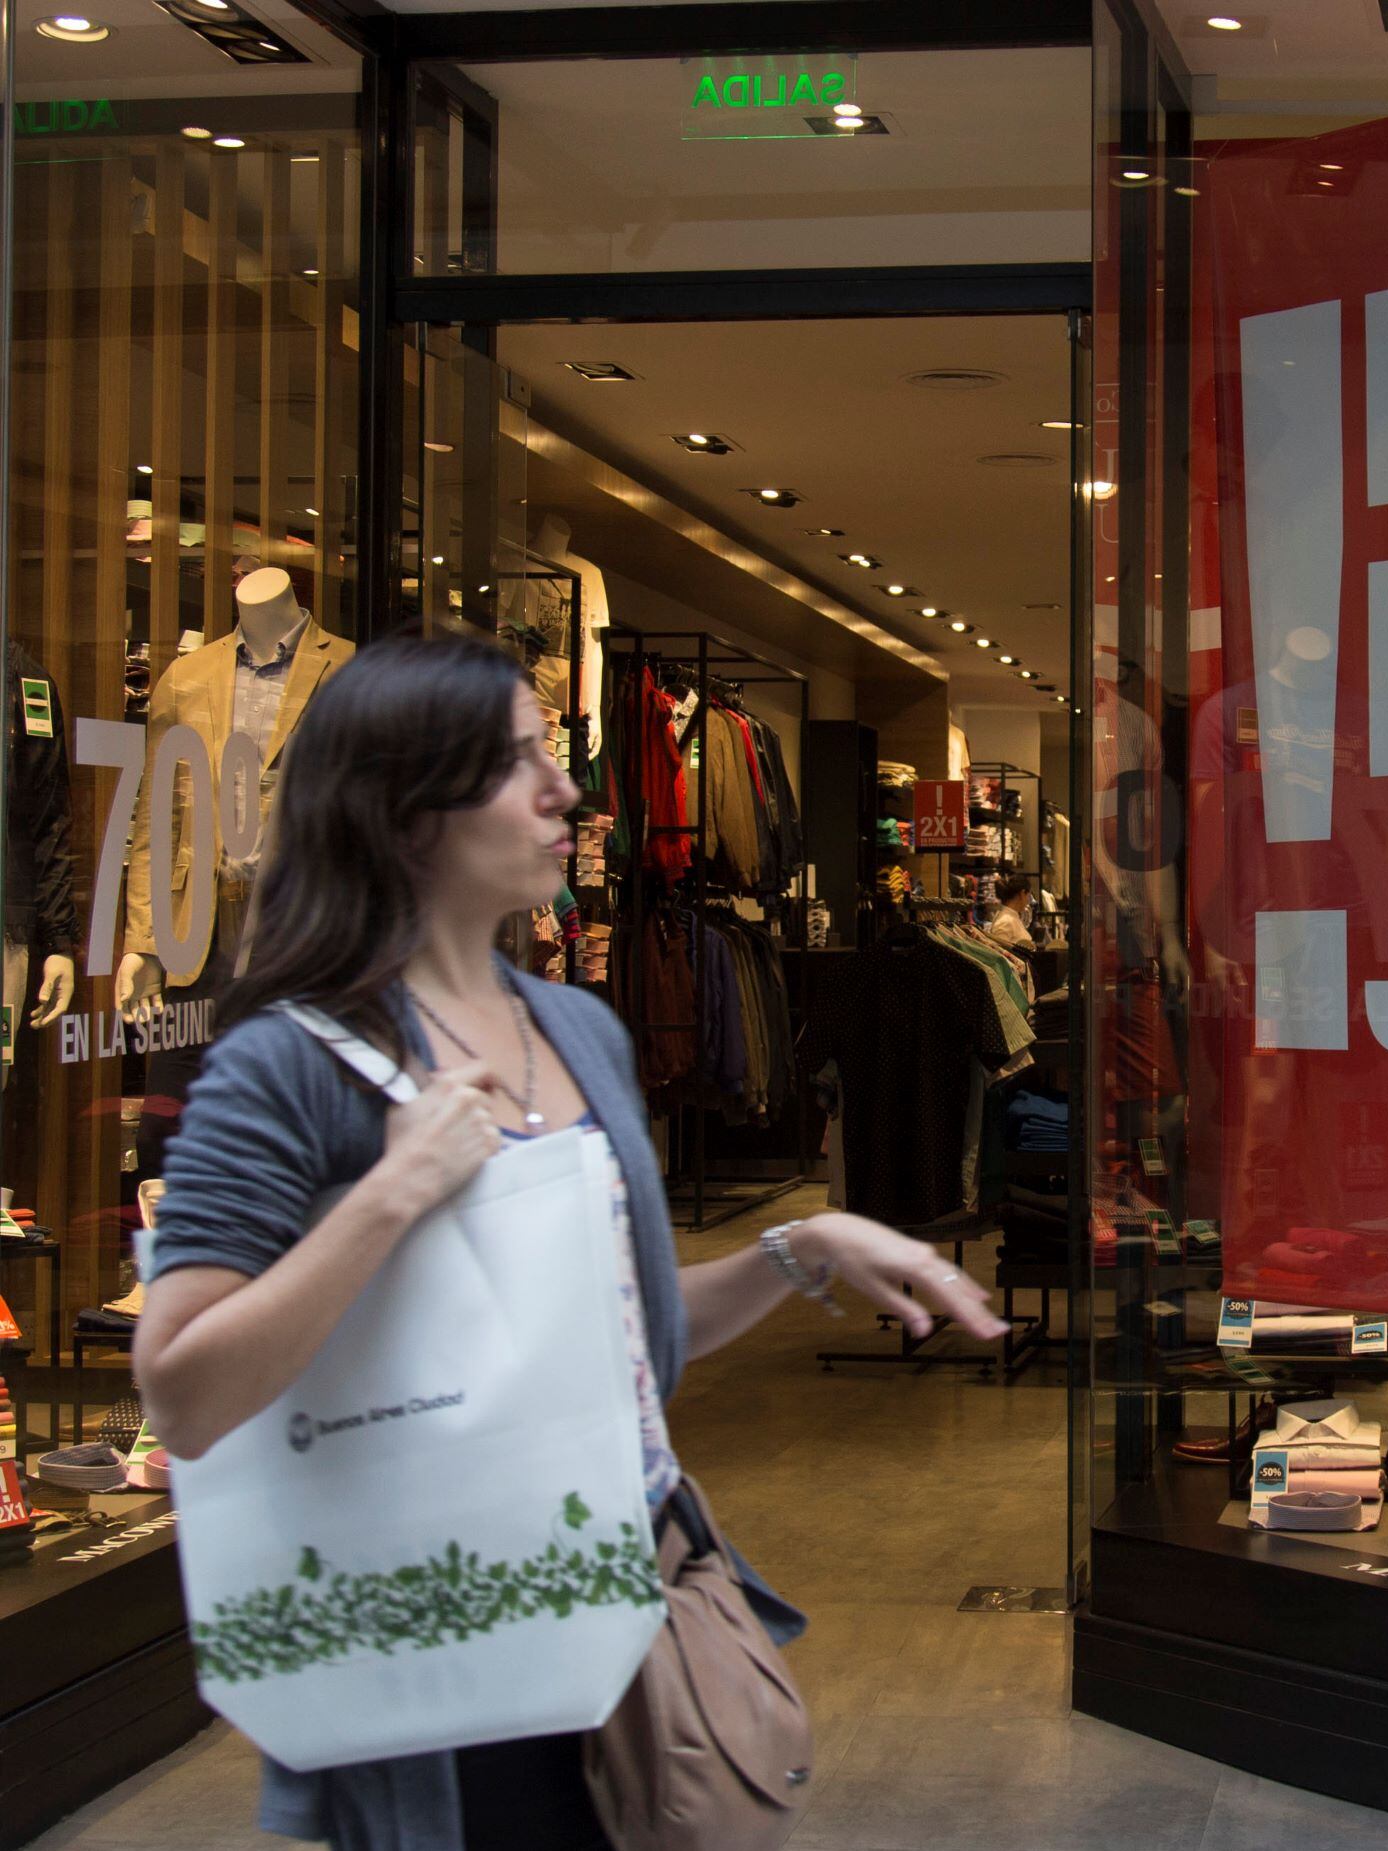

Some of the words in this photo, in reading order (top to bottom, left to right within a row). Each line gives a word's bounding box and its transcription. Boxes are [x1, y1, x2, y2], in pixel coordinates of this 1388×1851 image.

[920, 816, 957, 837] 2X1
[62, 1012, 89, 1064] EN
[98, 1009, 127, 1058] LA
[134, 998, 215, 1054] SEGUND
[1260, 1467, 1281, 1477] -50%
